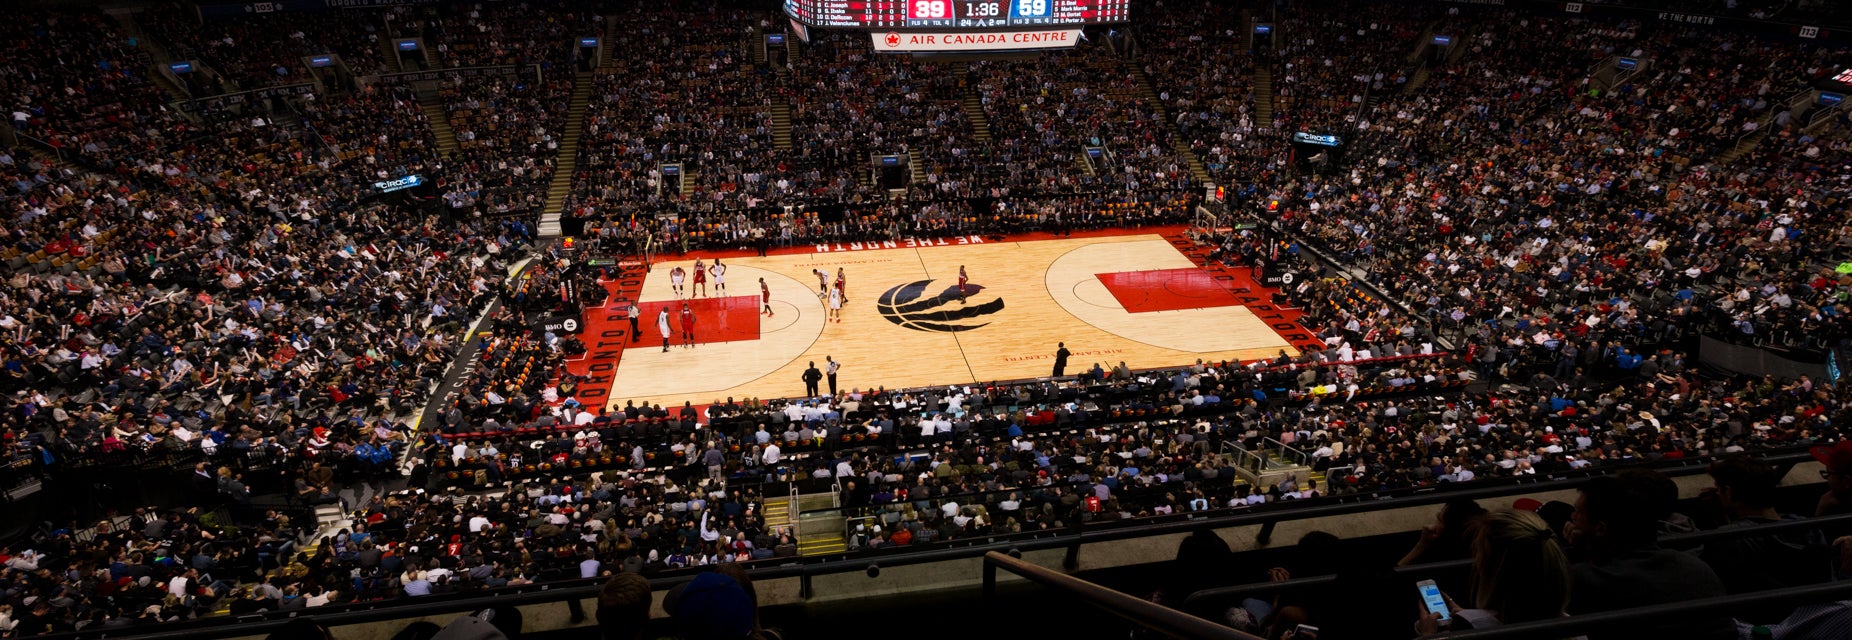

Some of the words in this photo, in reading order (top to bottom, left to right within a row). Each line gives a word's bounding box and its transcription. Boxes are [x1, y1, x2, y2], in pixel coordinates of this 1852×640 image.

[915, 1, 944, 18] 39
[966, 3, 999, 16] 1:36
[1019, 0, 1046, 16] 59
[910, 35, 935, 44] AIR
[943, 34, 1006, 44] CANADA
[1013, 32, 1067, 43] CENTRE
[816, 239, 897, 252] NORTH
[904, 237, 949, 248] THE
[955, 235, 984, 244] WE
